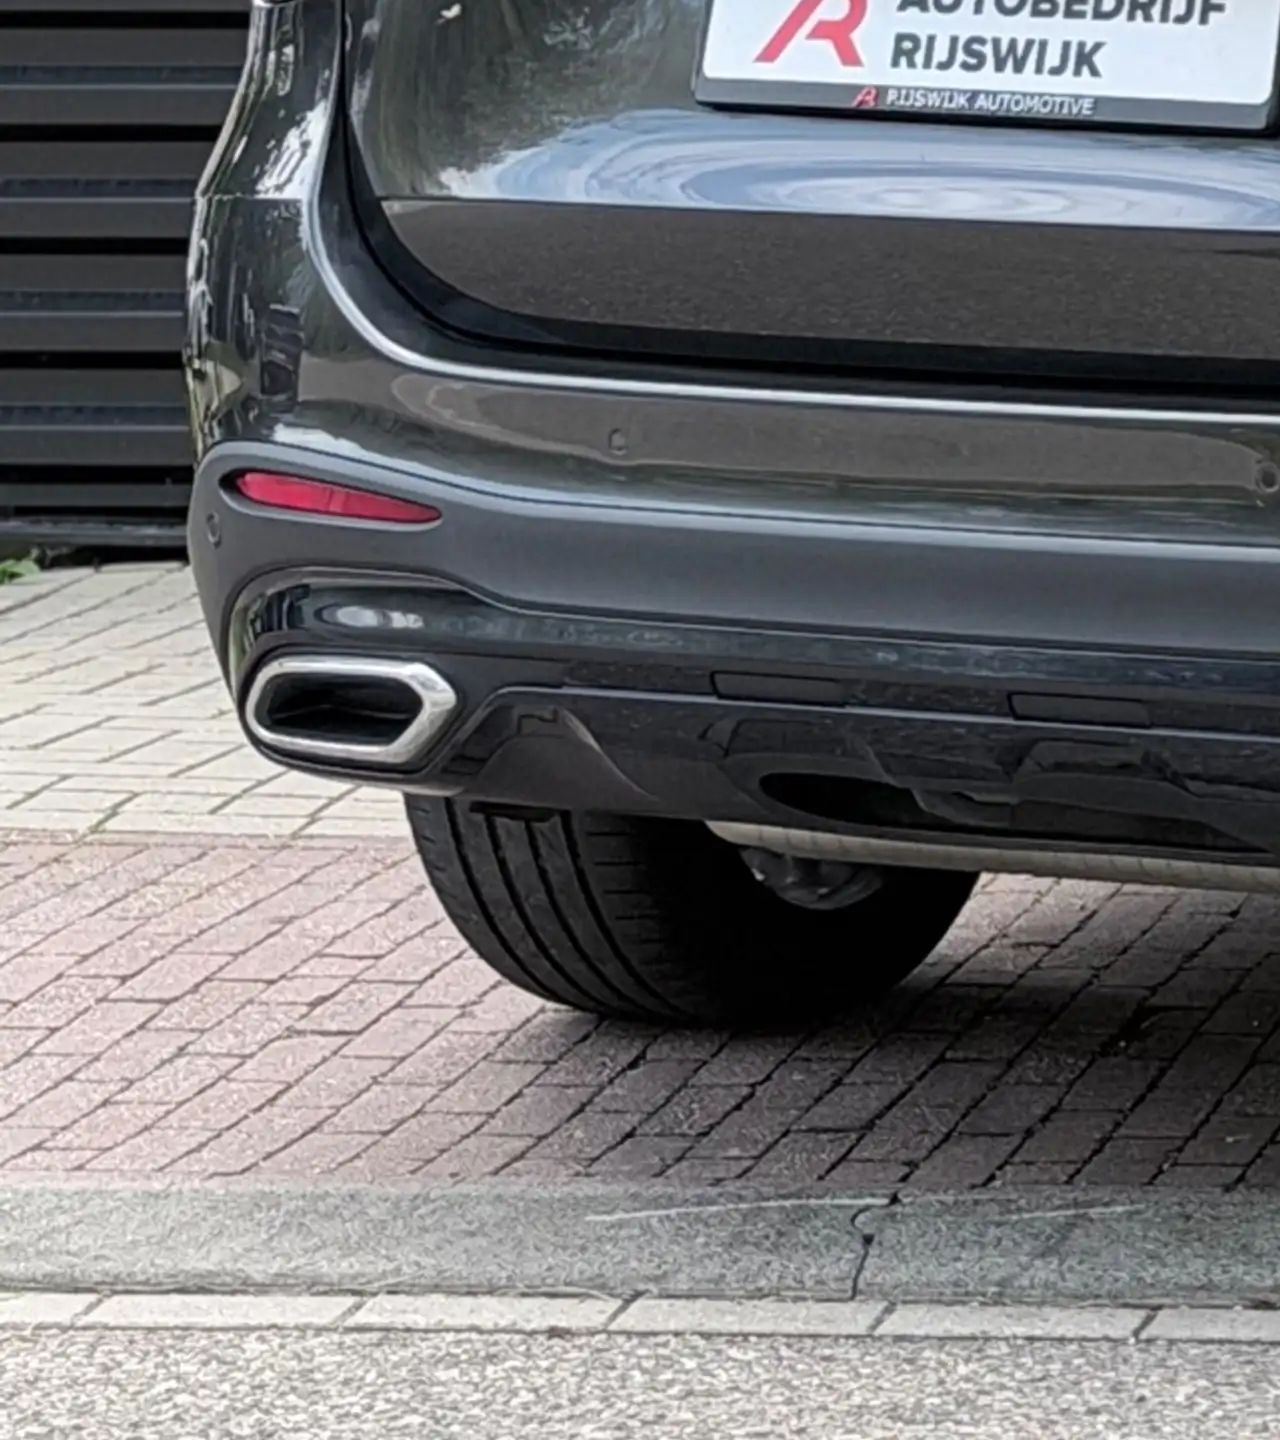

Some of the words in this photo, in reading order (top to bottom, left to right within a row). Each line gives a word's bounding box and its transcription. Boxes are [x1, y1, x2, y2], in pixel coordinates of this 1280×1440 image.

[890, 32, 1105, 77] RIJSWIJK
[886, 87, 971, 109] RIJSWIJK
[974, 92, 1095, 115] AUTOMOTIVE
